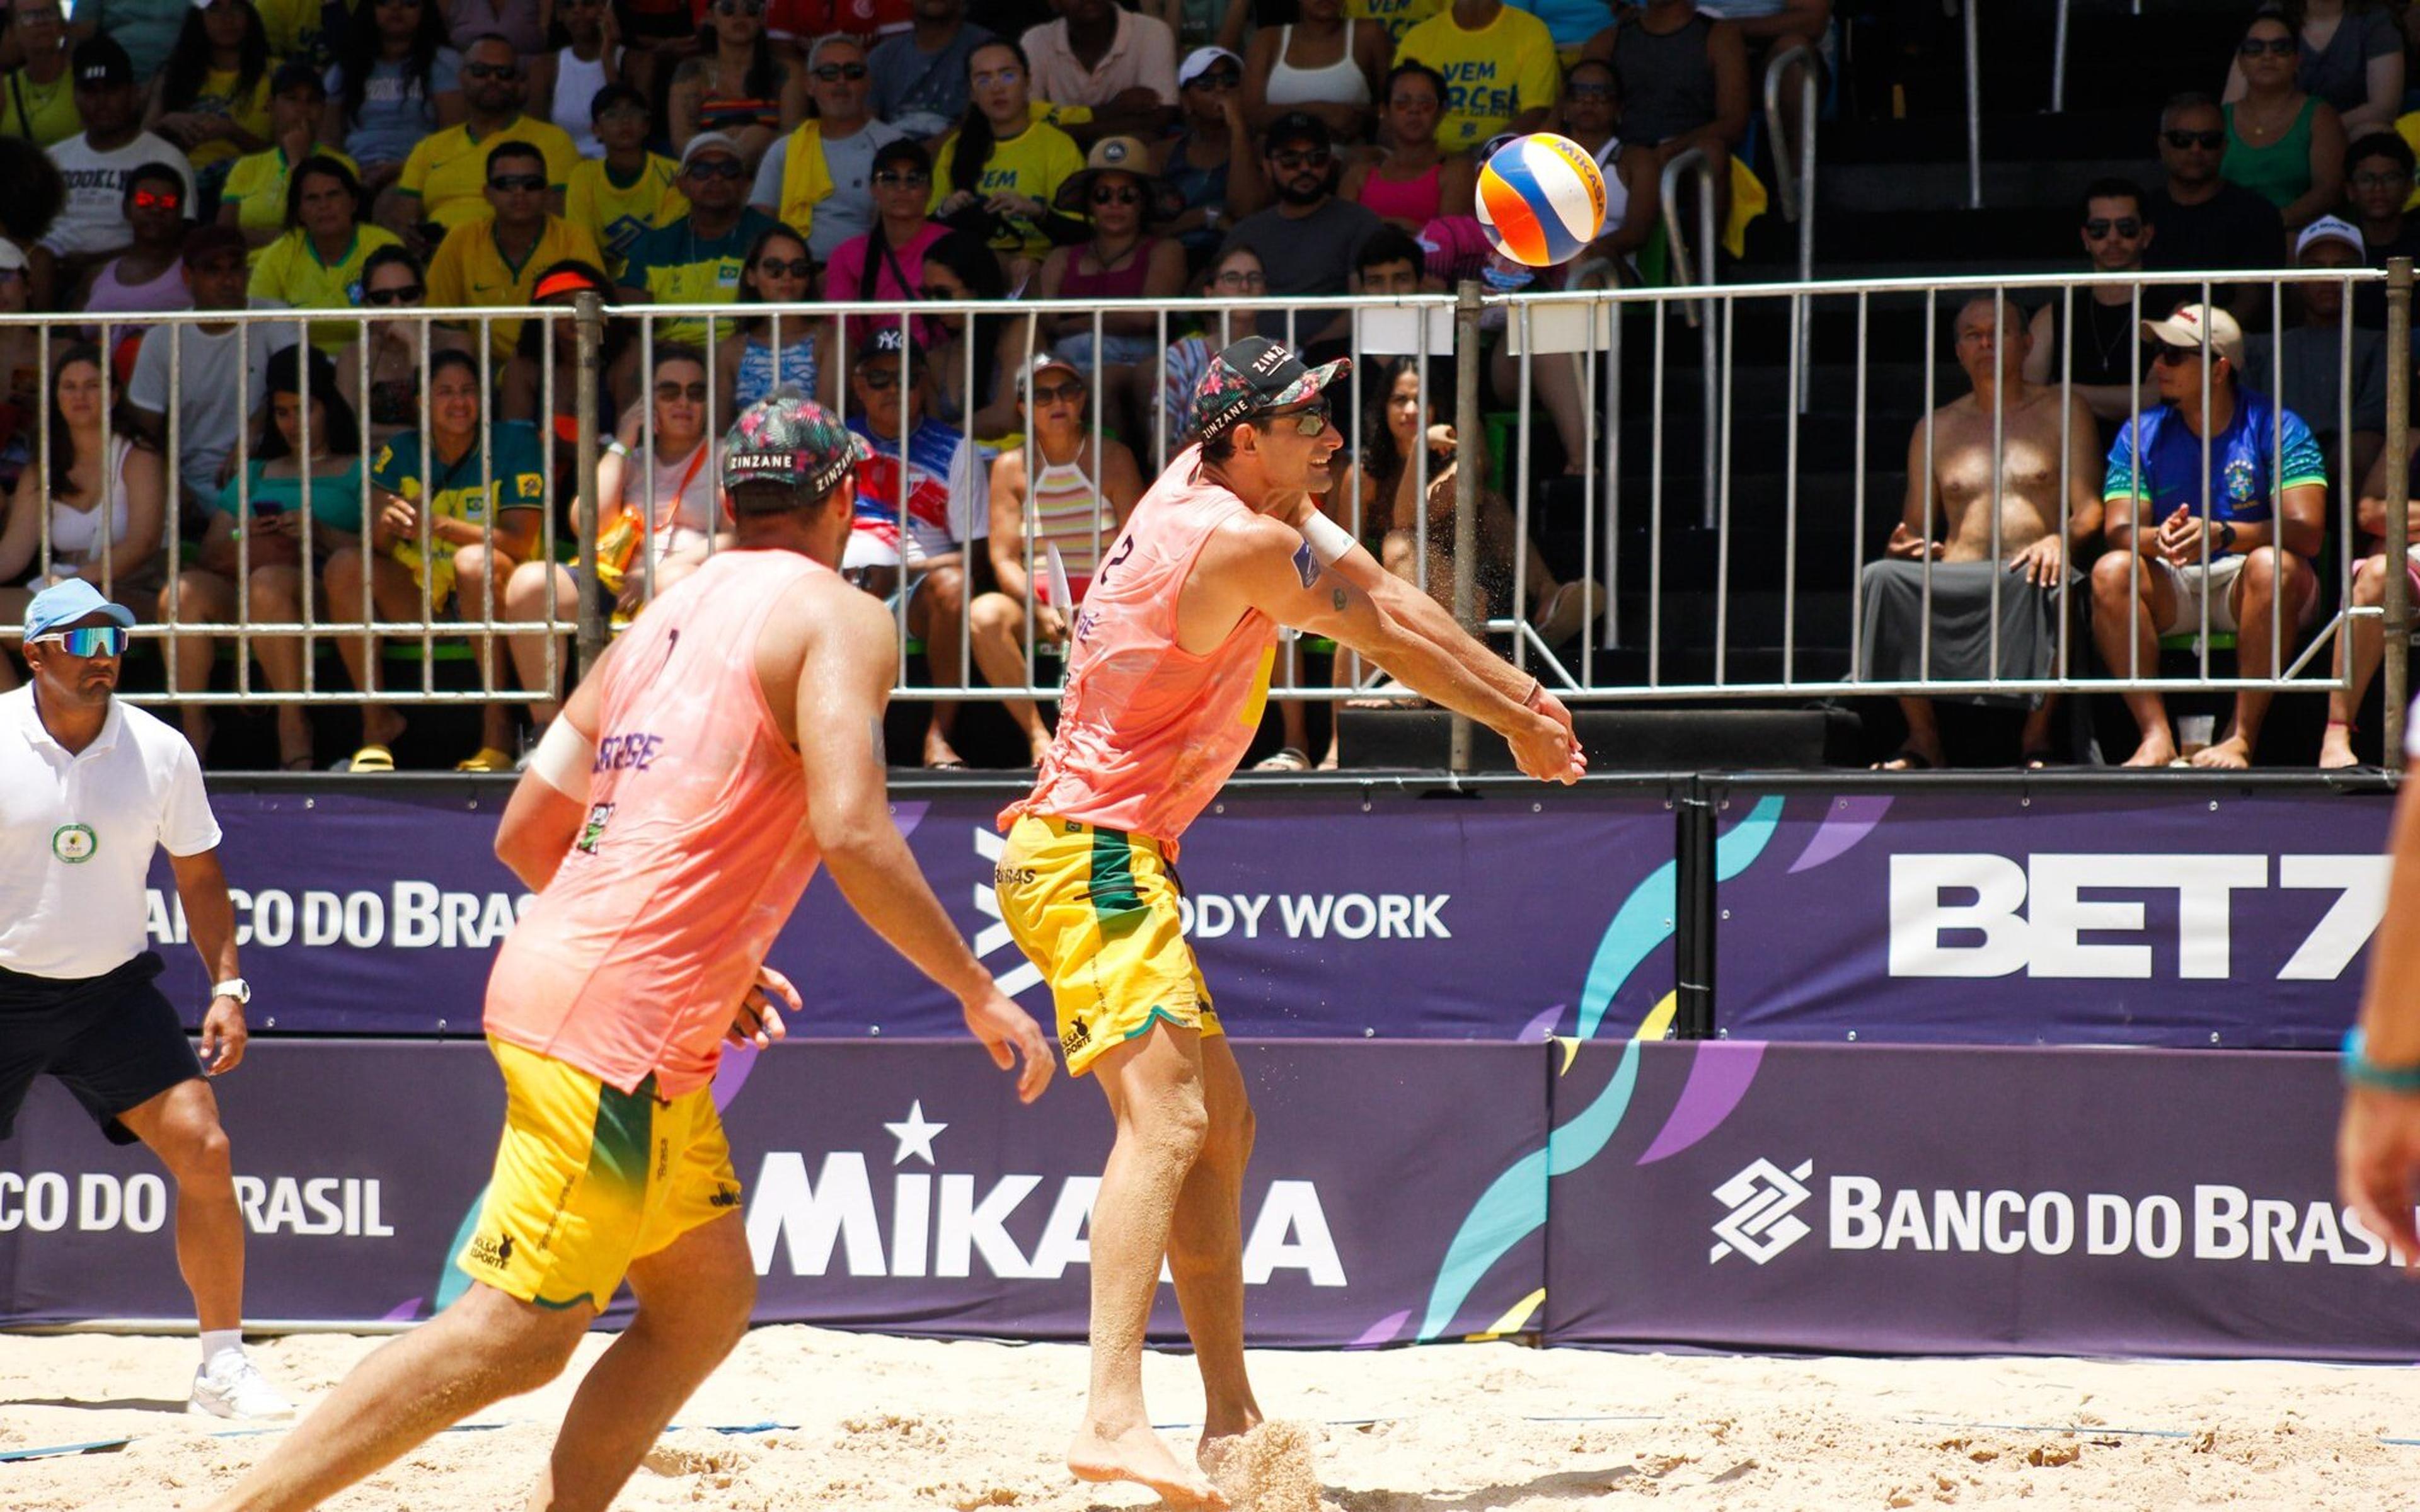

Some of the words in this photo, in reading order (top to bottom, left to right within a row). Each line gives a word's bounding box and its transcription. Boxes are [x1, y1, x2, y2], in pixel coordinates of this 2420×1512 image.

[1444, 61, 1495, 81] VEM
[984, 170, 1017, 188] EM
[1252, 345, 1287, 373] ZINZ
[1202, 400, 1248, 438] ZINZANE
[730, 455, 792, 469] ZINZANE
[816, 444, 855, 492] ZINZAN
[1101, 535, 1134, 585] 2
[146, 888, 293, 947] ACO
[304, 891, 384, 948] DO
[1279, 893, 1452, 940] WORK
[79, 1173, 166, 1233] DO
[232, 1176, 394, 1236] RASIL
[746, 1150, 1347, 1287] MIKAA
[1830, 1176, 2075, 1254] BANCO
[2087, 1194, 2182, 1259] DO
